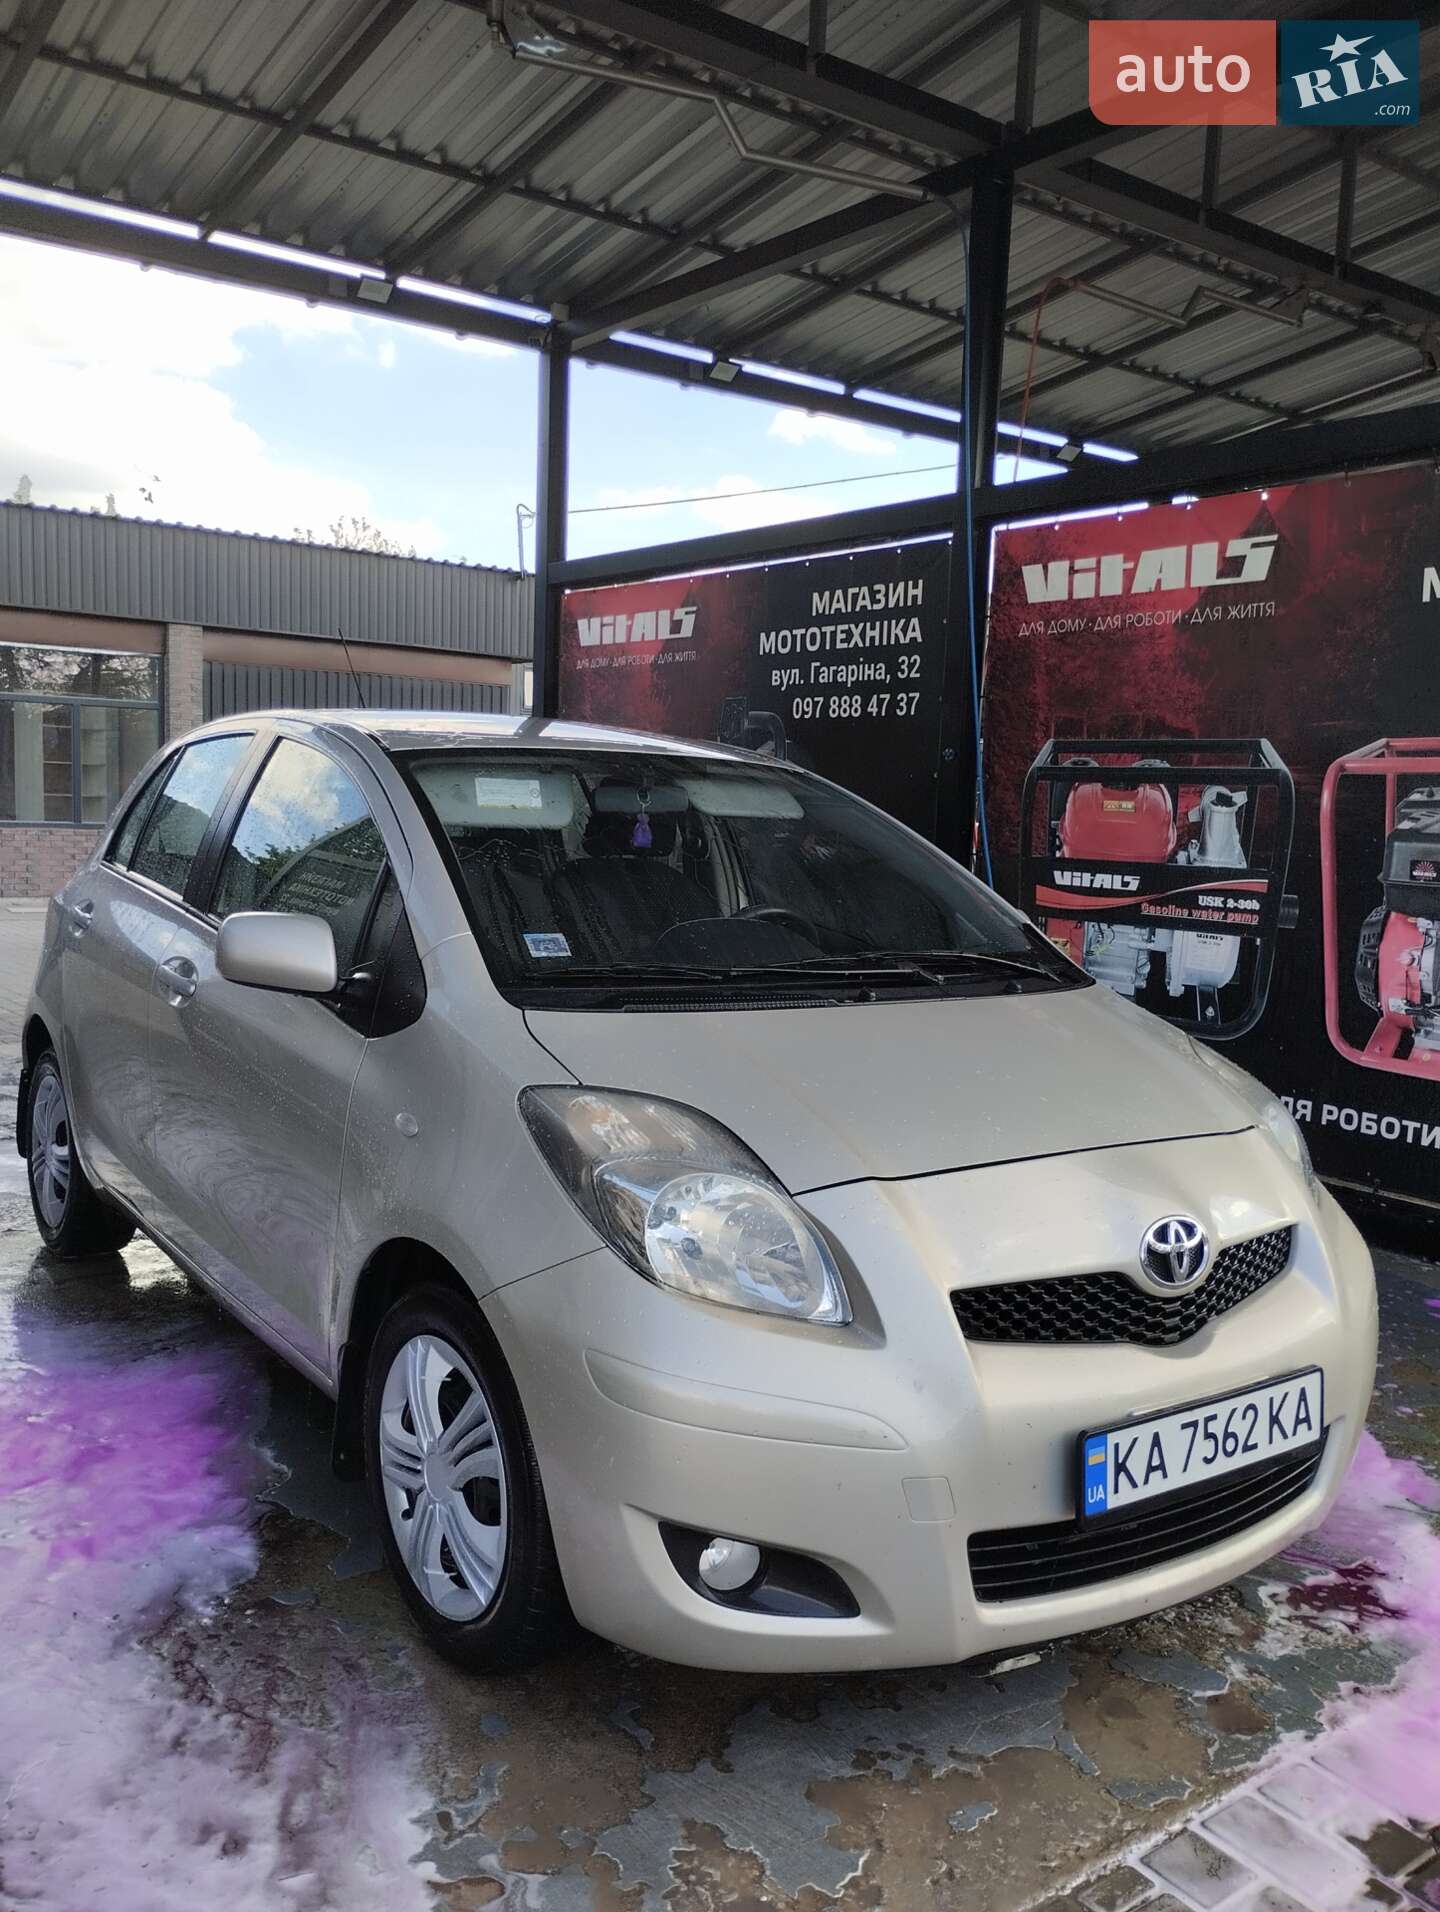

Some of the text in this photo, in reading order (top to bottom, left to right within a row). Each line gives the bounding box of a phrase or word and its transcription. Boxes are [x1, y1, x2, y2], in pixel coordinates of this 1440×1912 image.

[812, 579, 923, 616] МАГАЗИН
[759, 617, 923, 655] МОТОТЕХНІКА
[1018, 602, 1276, 637] ДЛЯ ДОМУ ДЛЯ РОБОТИ ДЛЯ ЖИТТЯ
[657, 652, 673, 664] ДЛЯ
[771, 654, 921, 691] вул. Гагаріна, 32
[792, 692, 920, 719] 097 888 47 37
[1141, 902, 1259, 924] Gasoline water pump
[1198, 895, 1225, 908] USK
[1320, 1103, 1440, 1149] РОБОТИ
[1113, 1386, 1313, 1495] KA 7562 KA
[1088, 1484, 1105, 1503] UA
